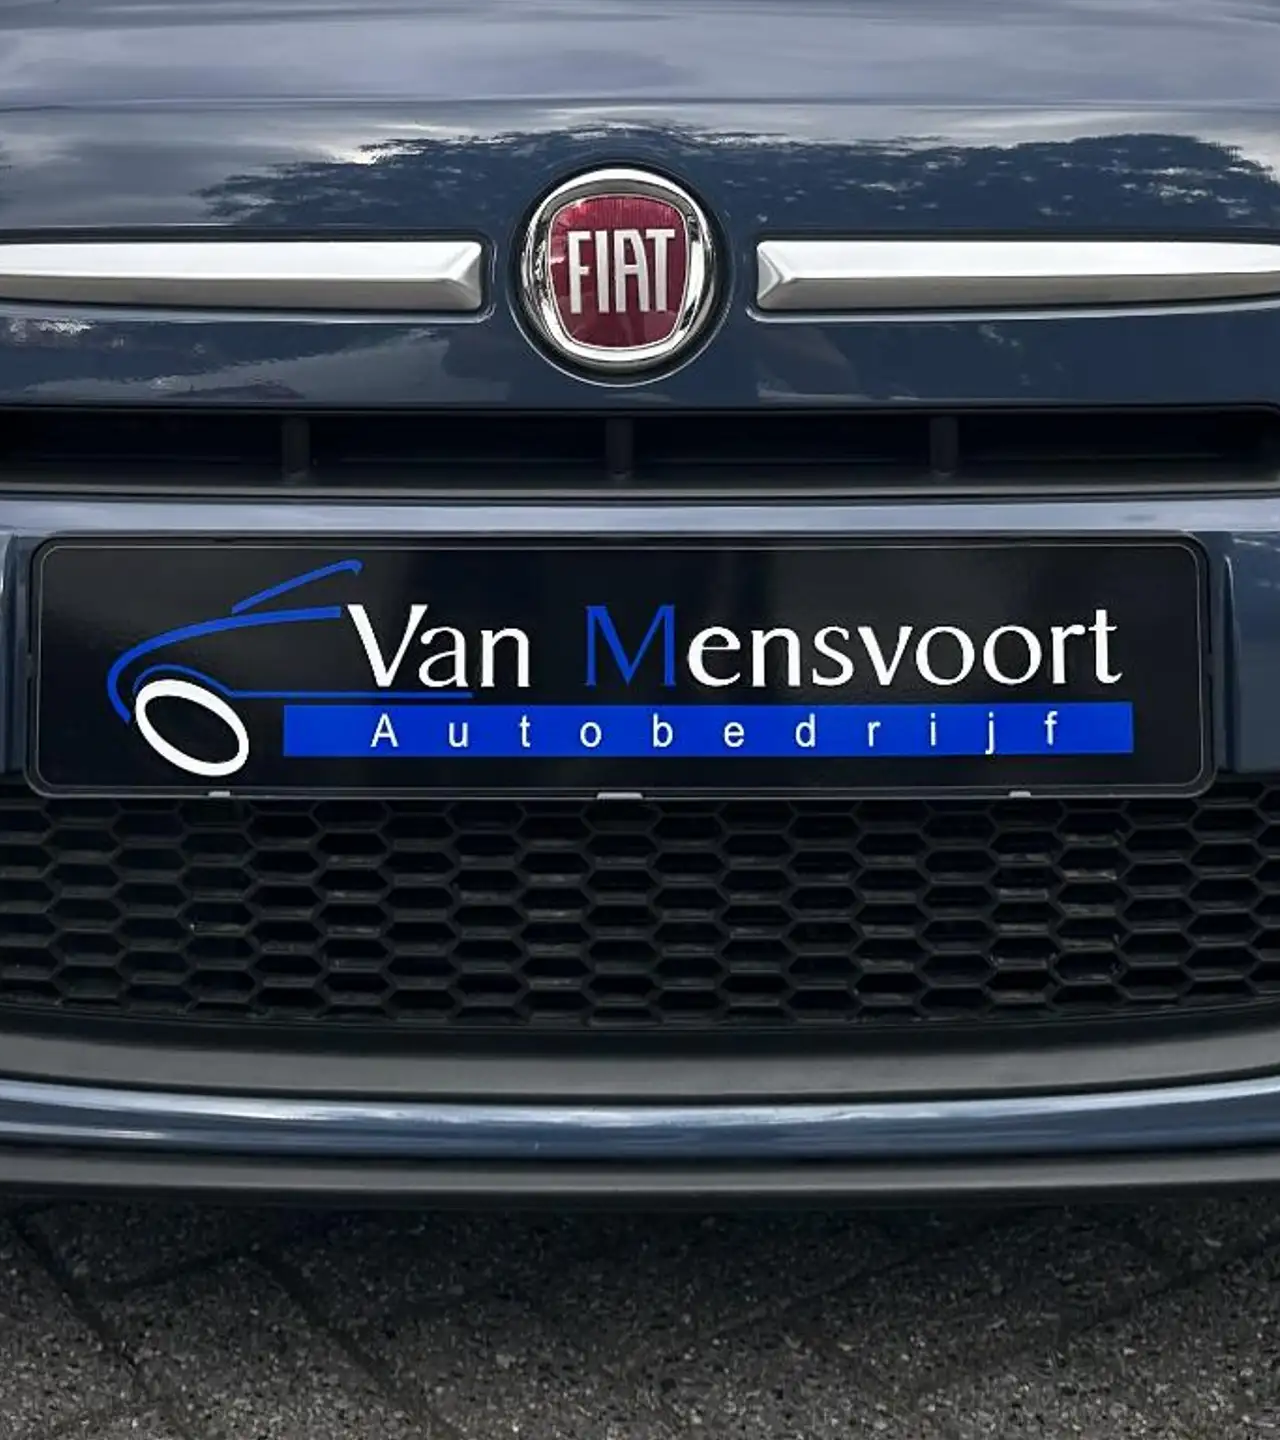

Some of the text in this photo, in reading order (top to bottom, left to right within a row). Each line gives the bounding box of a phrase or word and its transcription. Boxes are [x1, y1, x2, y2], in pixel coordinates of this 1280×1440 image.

[566, 227, 676, 316] FIAT
[345, 603, 1123, 688] Van Mensvoort
